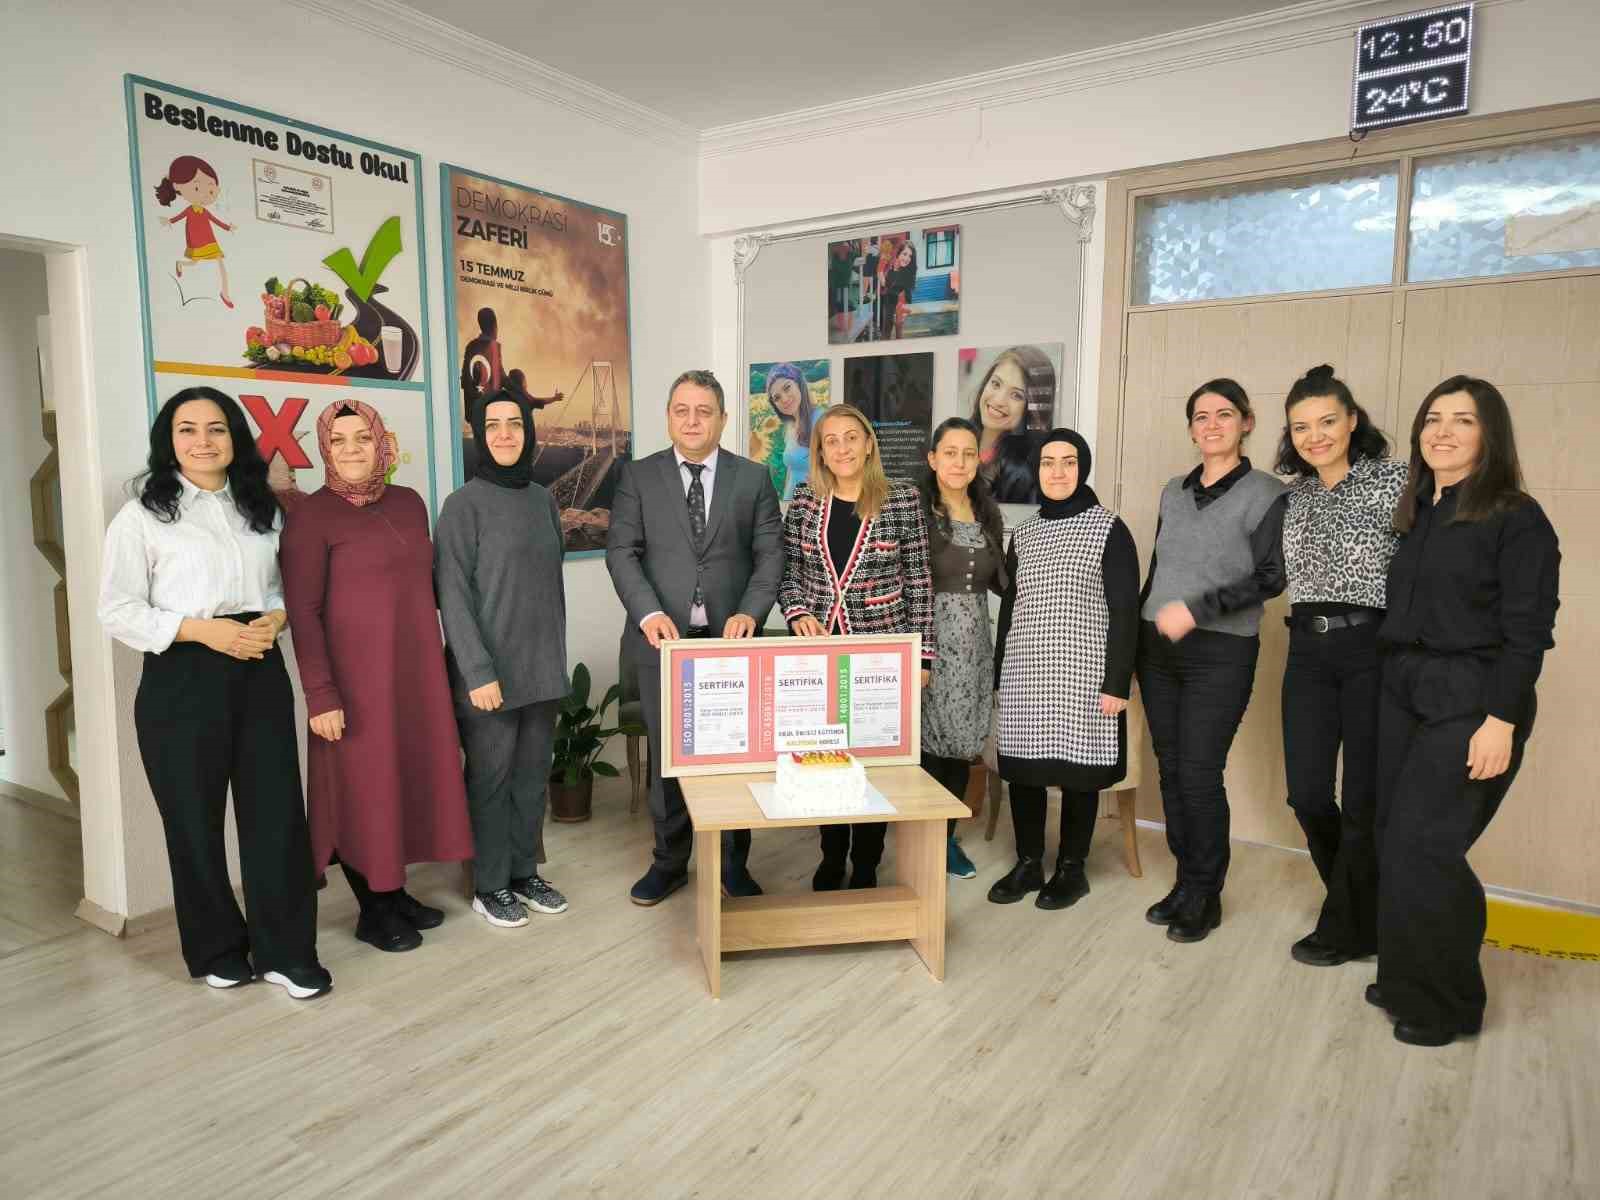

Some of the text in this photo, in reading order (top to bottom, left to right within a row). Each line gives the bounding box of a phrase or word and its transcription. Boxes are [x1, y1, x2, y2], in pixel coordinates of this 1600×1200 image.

[143, 92, 409, 184] Beslenme Dostu Okul
[456, 186, 569, 233] DEMOKRASİ
[456, 214, 529, 250] ZAFERİ
[460, 259, 526, 283] 15 TEMMUZ
